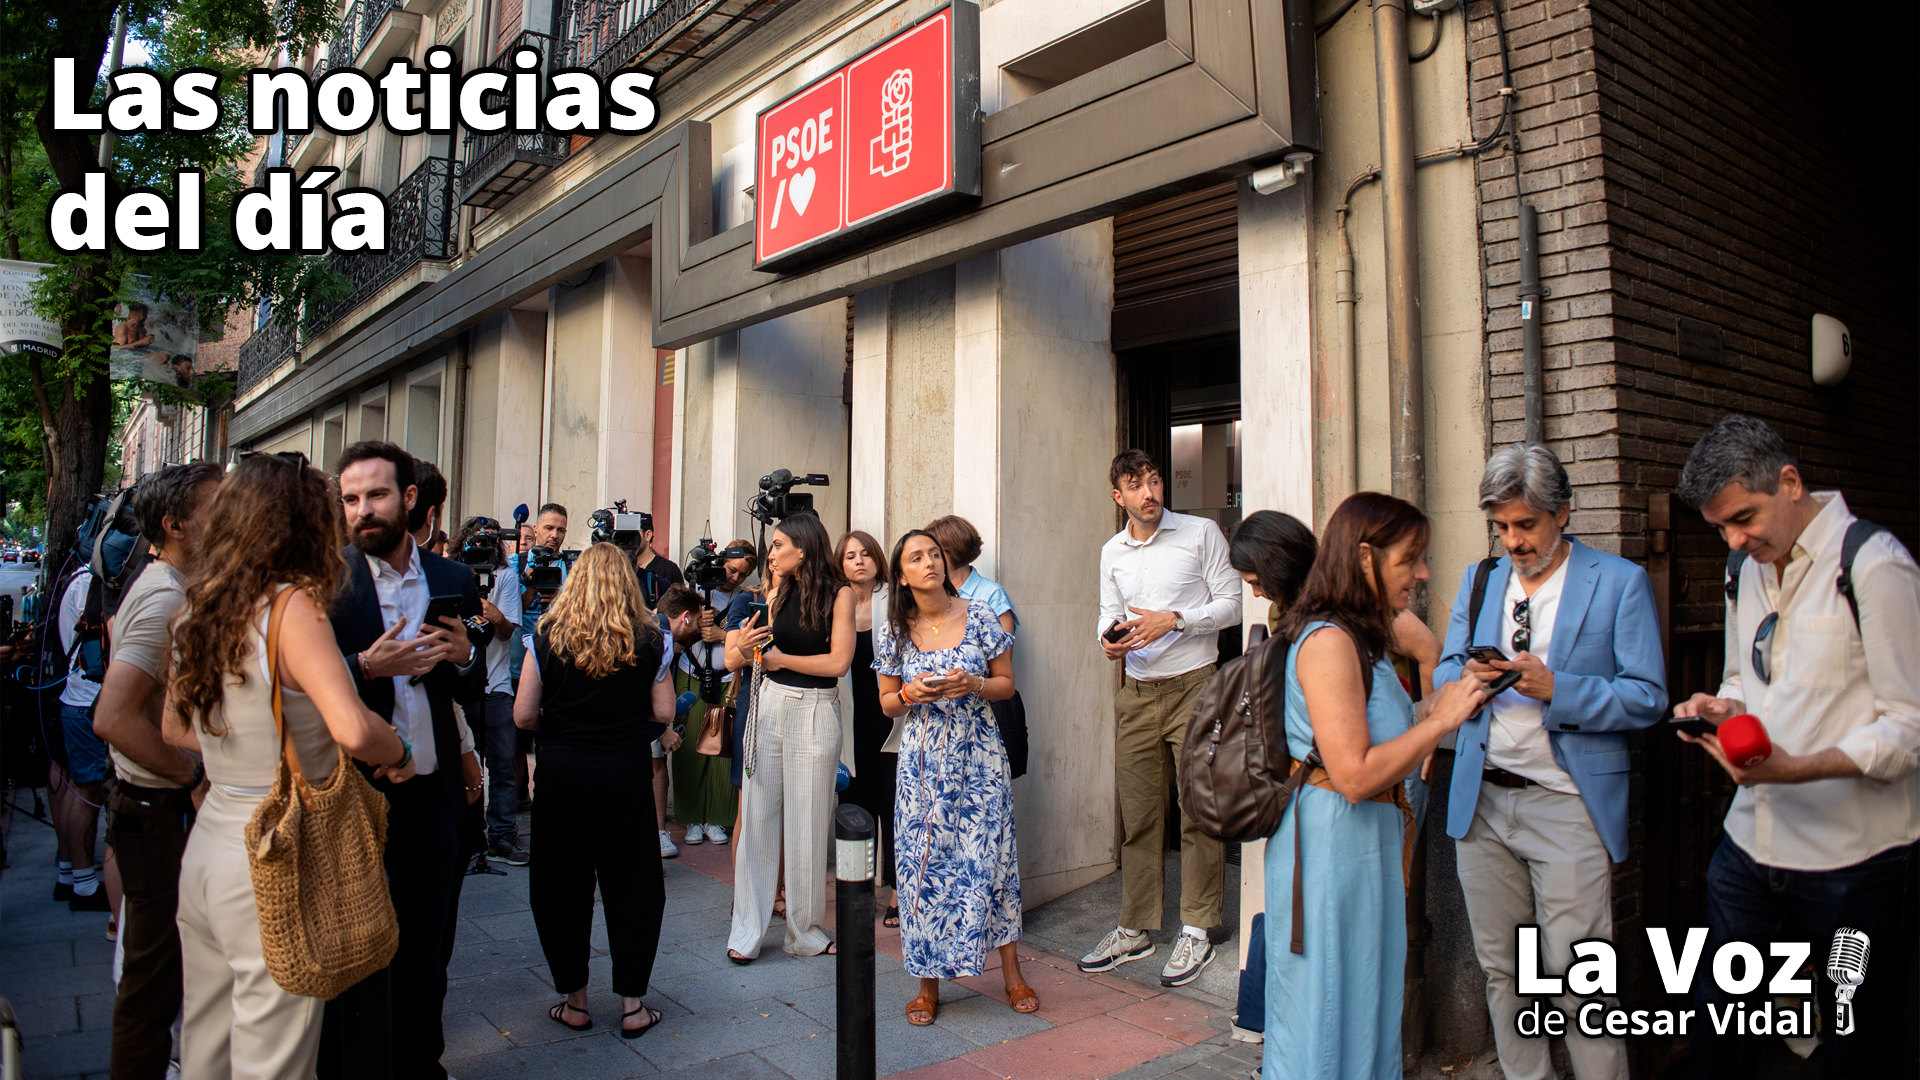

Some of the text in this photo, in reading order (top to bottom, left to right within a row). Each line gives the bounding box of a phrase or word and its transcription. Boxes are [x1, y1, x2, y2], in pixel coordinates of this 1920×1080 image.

[771, 107, 833, 178] PSOE
[31, 322, 42, 330] DE
[22, 344, 58, 357] MADRID
[1842, 333, 1850, 357] 6
[1175, 470, 1192, 479] PSOE
